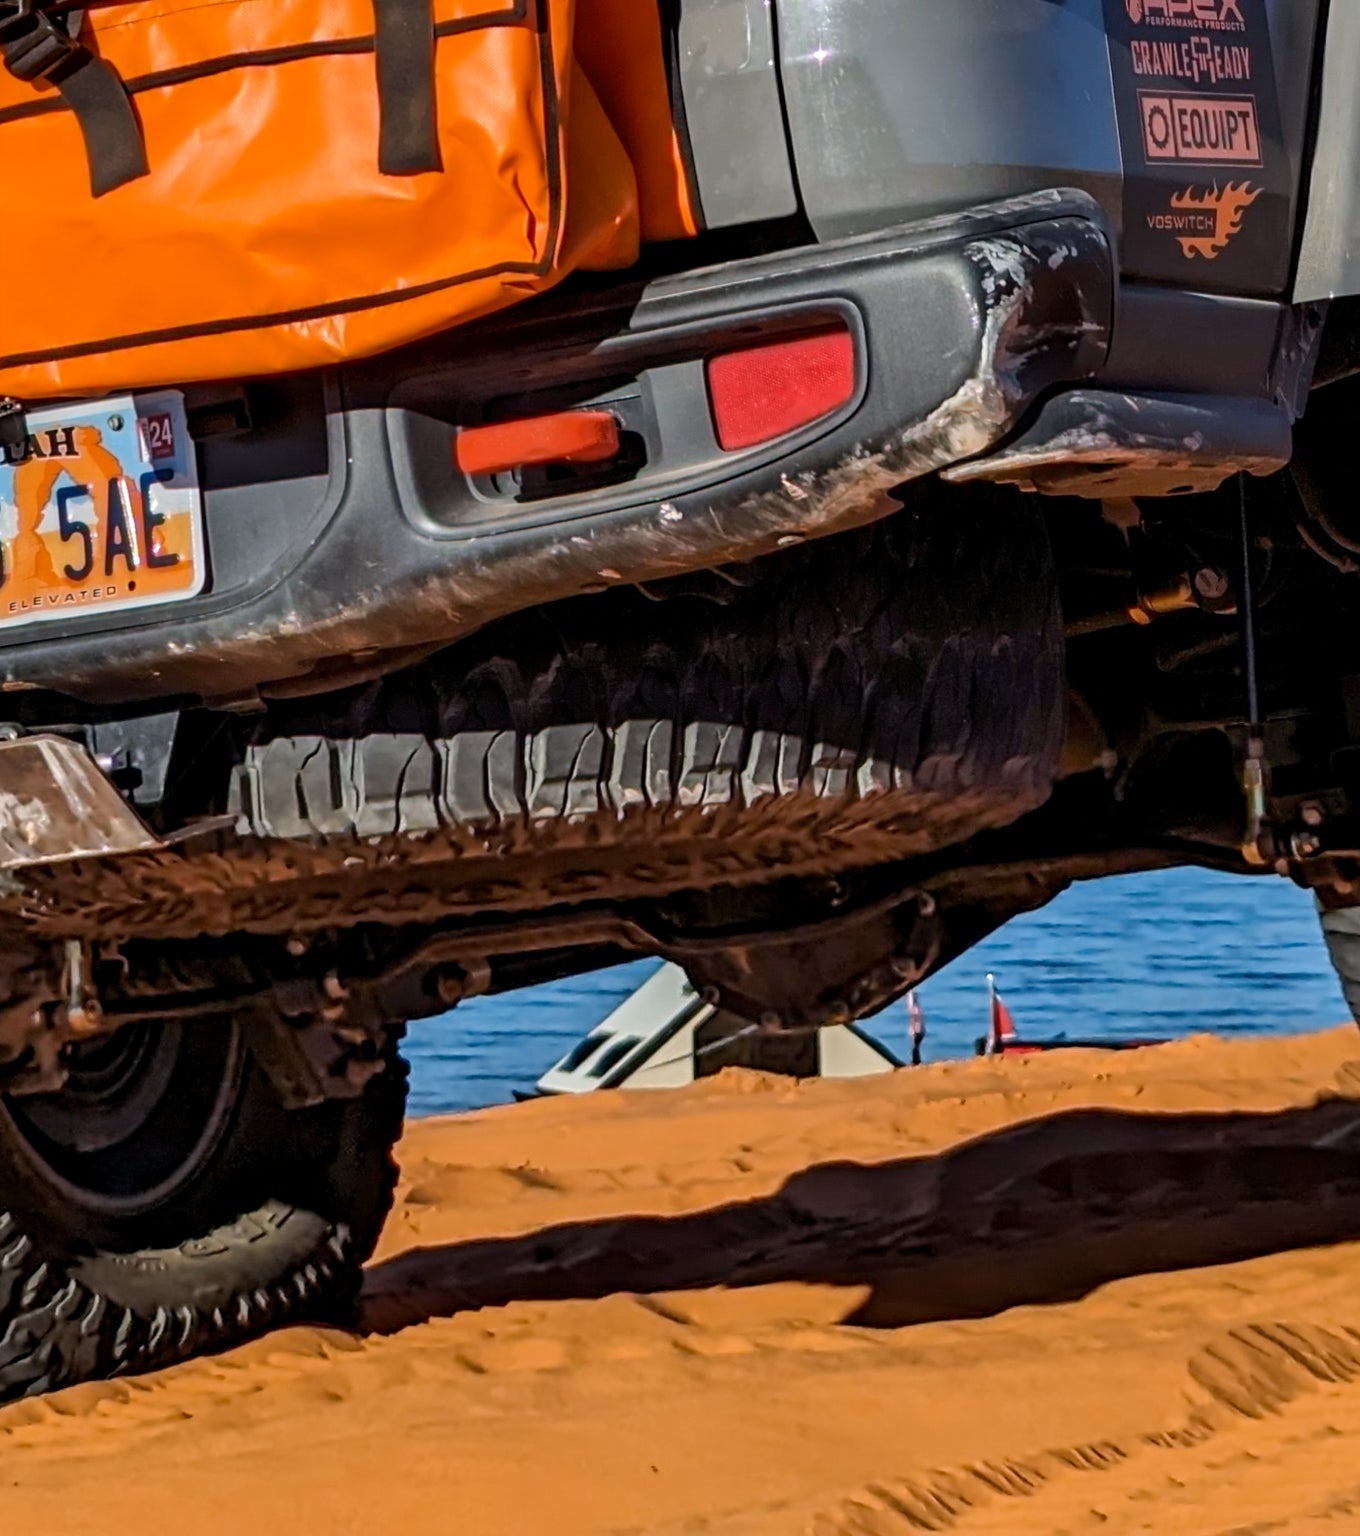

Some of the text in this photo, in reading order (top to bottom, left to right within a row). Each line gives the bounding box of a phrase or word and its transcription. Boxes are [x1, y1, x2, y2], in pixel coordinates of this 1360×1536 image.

[1145, 15, 1246, 32] PERFORMANCE PRODUCTS
[1176, 106, 1251, 151] EQUIPT
[1146, 214, 1215, 231] VOSWITCH
[149, 418, 173, 448] 24
[8, 585, 119, 613] ELEVATED
